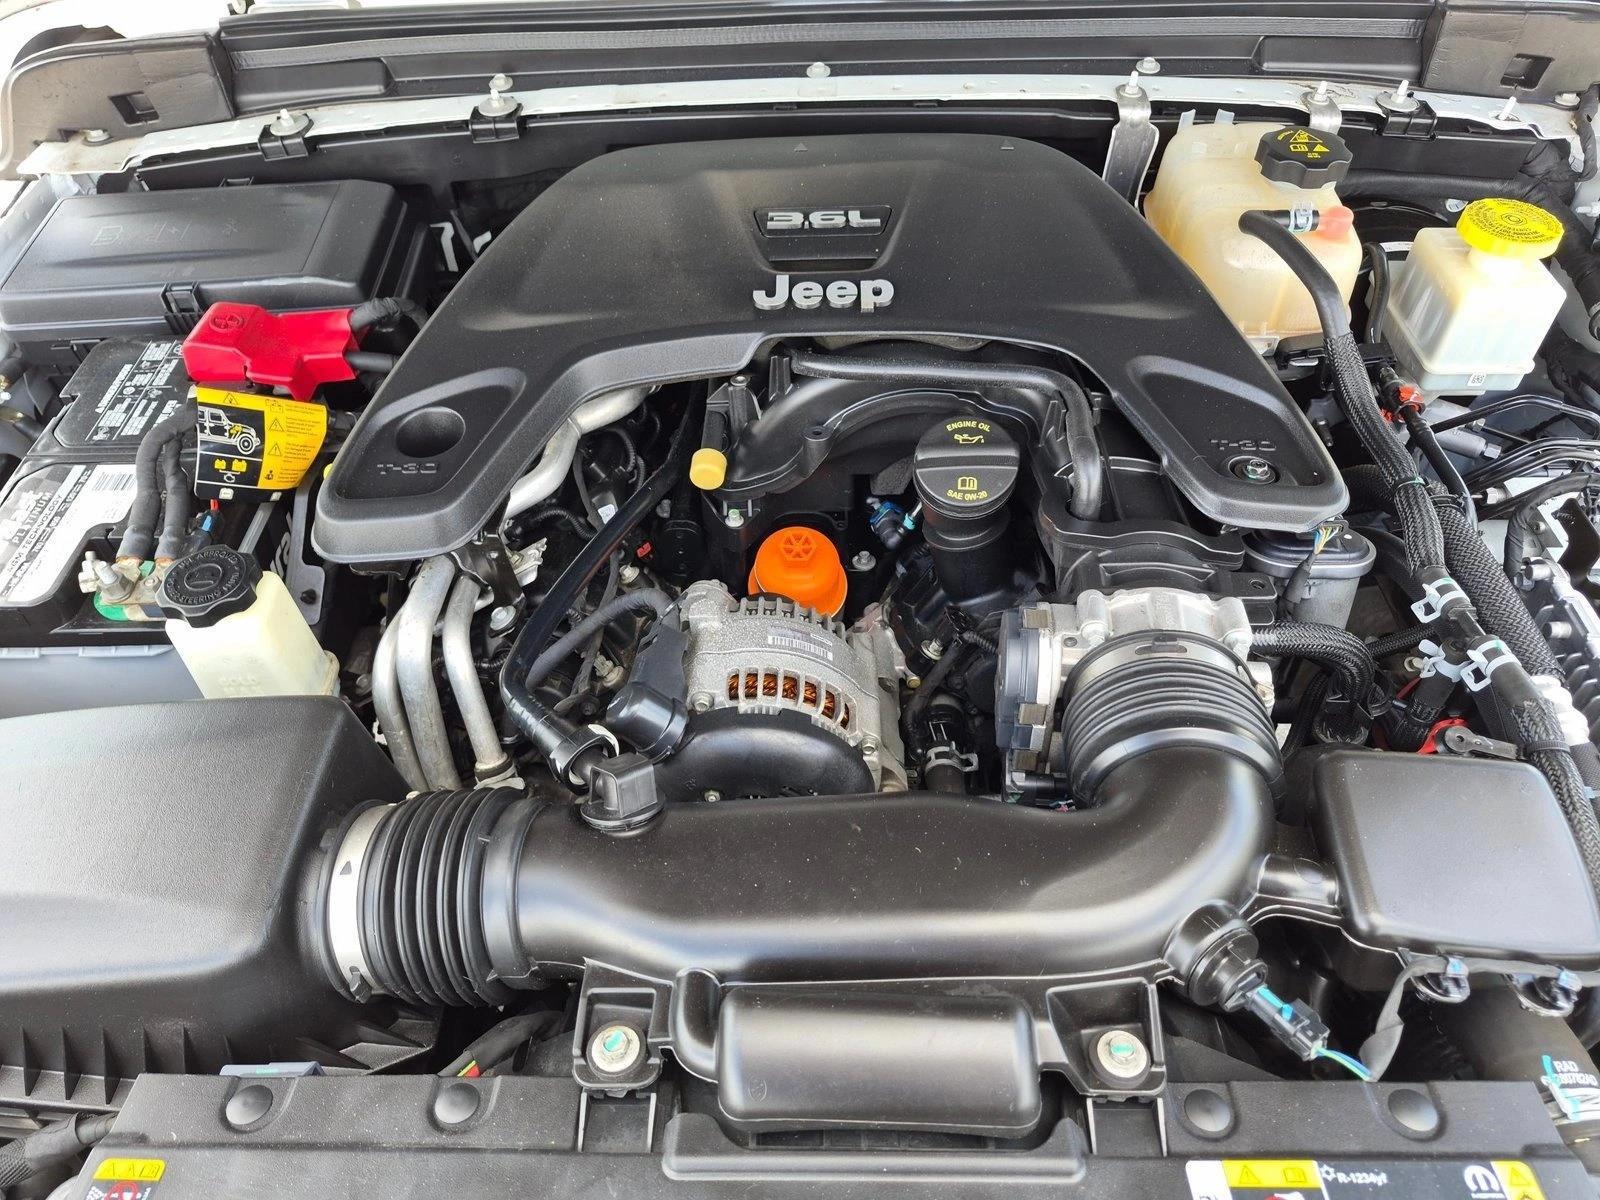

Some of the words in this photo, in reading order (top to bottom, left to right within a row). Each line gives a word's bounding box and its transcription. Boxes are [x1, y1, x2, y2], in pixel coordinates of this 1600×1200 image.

[767, 210, 881, 229] 3.6L
[752, 274, 894, 313] Jeep
[946, 420, 977, 432] ENGINE
[978, 422, 991, 433] OIL
[946, 489, 963, 500] SAE
[964, 490, 988, 501] 0W-20
[11, 490, 55, 544] PLATINUM
[22, 494, 63, 550] TECHNOLOGY
[1552, 1060, 1580, 1073] RAD
